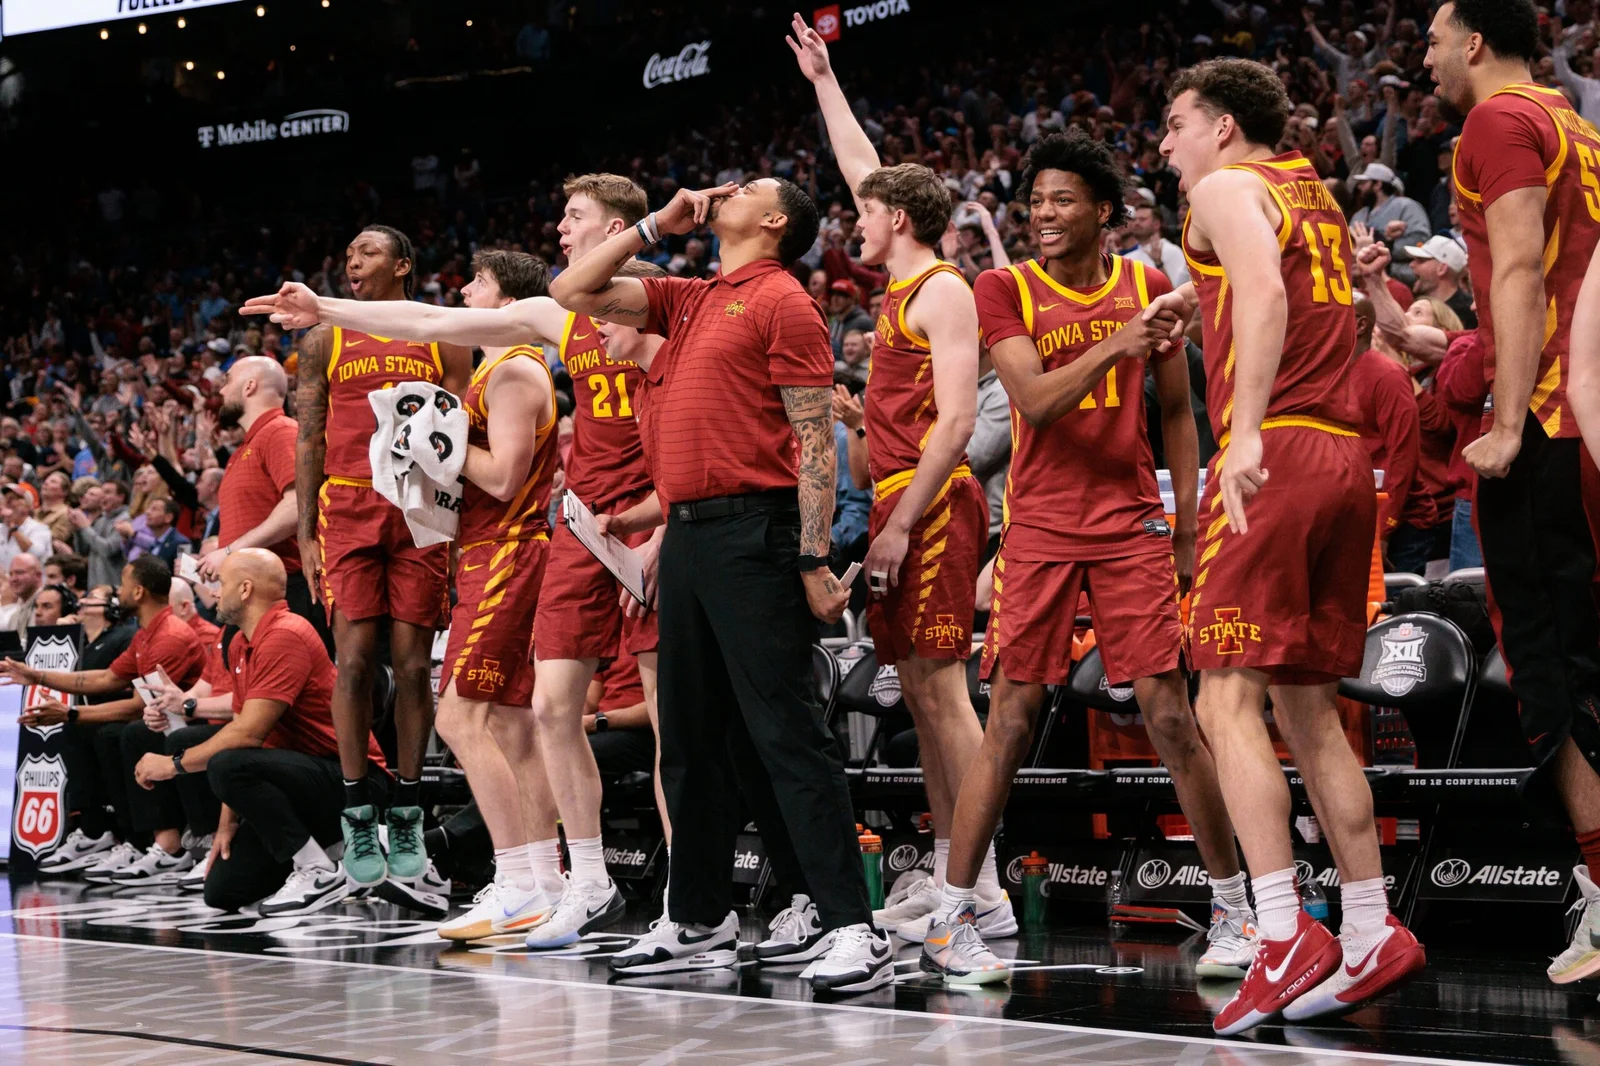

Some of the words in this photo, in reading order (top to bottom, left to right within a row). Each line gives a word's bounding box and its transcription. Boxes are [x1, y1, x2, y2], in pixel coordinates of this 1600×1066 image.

[843, 0, 910, 27] TOYOTA
[217, 119, 277, 146] Mobile
[280, 115, 343, 138] CENTER
[1301, 220, 1352, 306] 13
[1036, 322, 1085, 361] IOWA
[338, 355, 379, 383] IOWA
[385, 355, 434, 382] STATE
[567, 349, 600, 378] IOWA
[587, 372, 633, 418] 21
[925, 625, 964, 641] STATE
[1200, 622, 1262, 645] STATE
[33, 652, 70, 670] PHILLIPS
[467, 669, 506, 686] STATE
[24, 770, 60, 788] PHILLIPS
[1012, 777, 1068, 785] CONFERENCE
[1116, 776, 1132, 784] BIG
[1134, 776, 1145, 784] 12
[1147, 776, 1175, 784] CONF
[1408, 778, 1427, 786] BIG
[1429, 778, 1442, 786] 12
[1445, 778, 1518, 786] CONFERENCE
[22, 796, 56, 835] 66
[1468, 864, 1560, 886] Allstate
